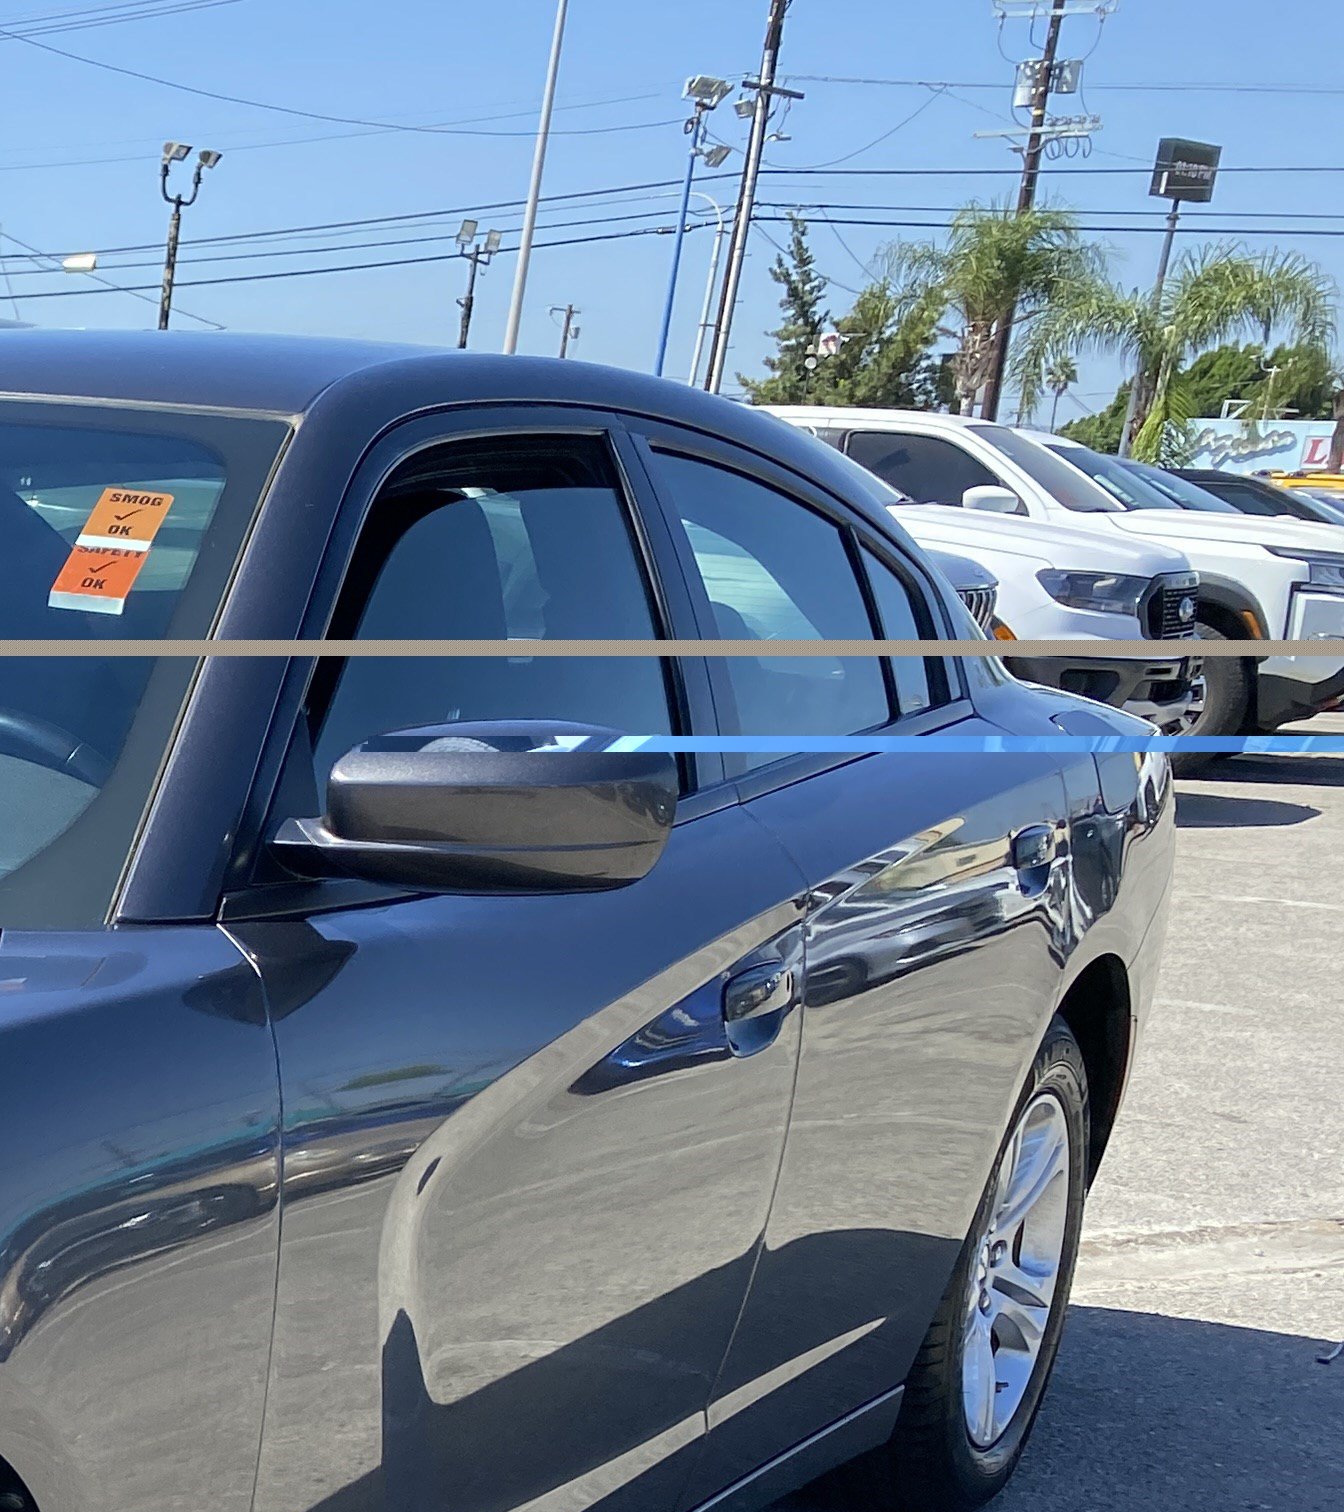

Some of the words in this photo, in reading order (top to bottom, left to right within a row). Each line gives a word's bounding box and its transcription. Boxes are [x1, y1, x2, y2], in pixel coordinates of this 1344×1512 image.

[110, 493, 164, 506] SMOG
[107, 525, 133, 536] OK
[77, 545, 144, 557] SAFETY
[81, 577, 108, 590] OK
